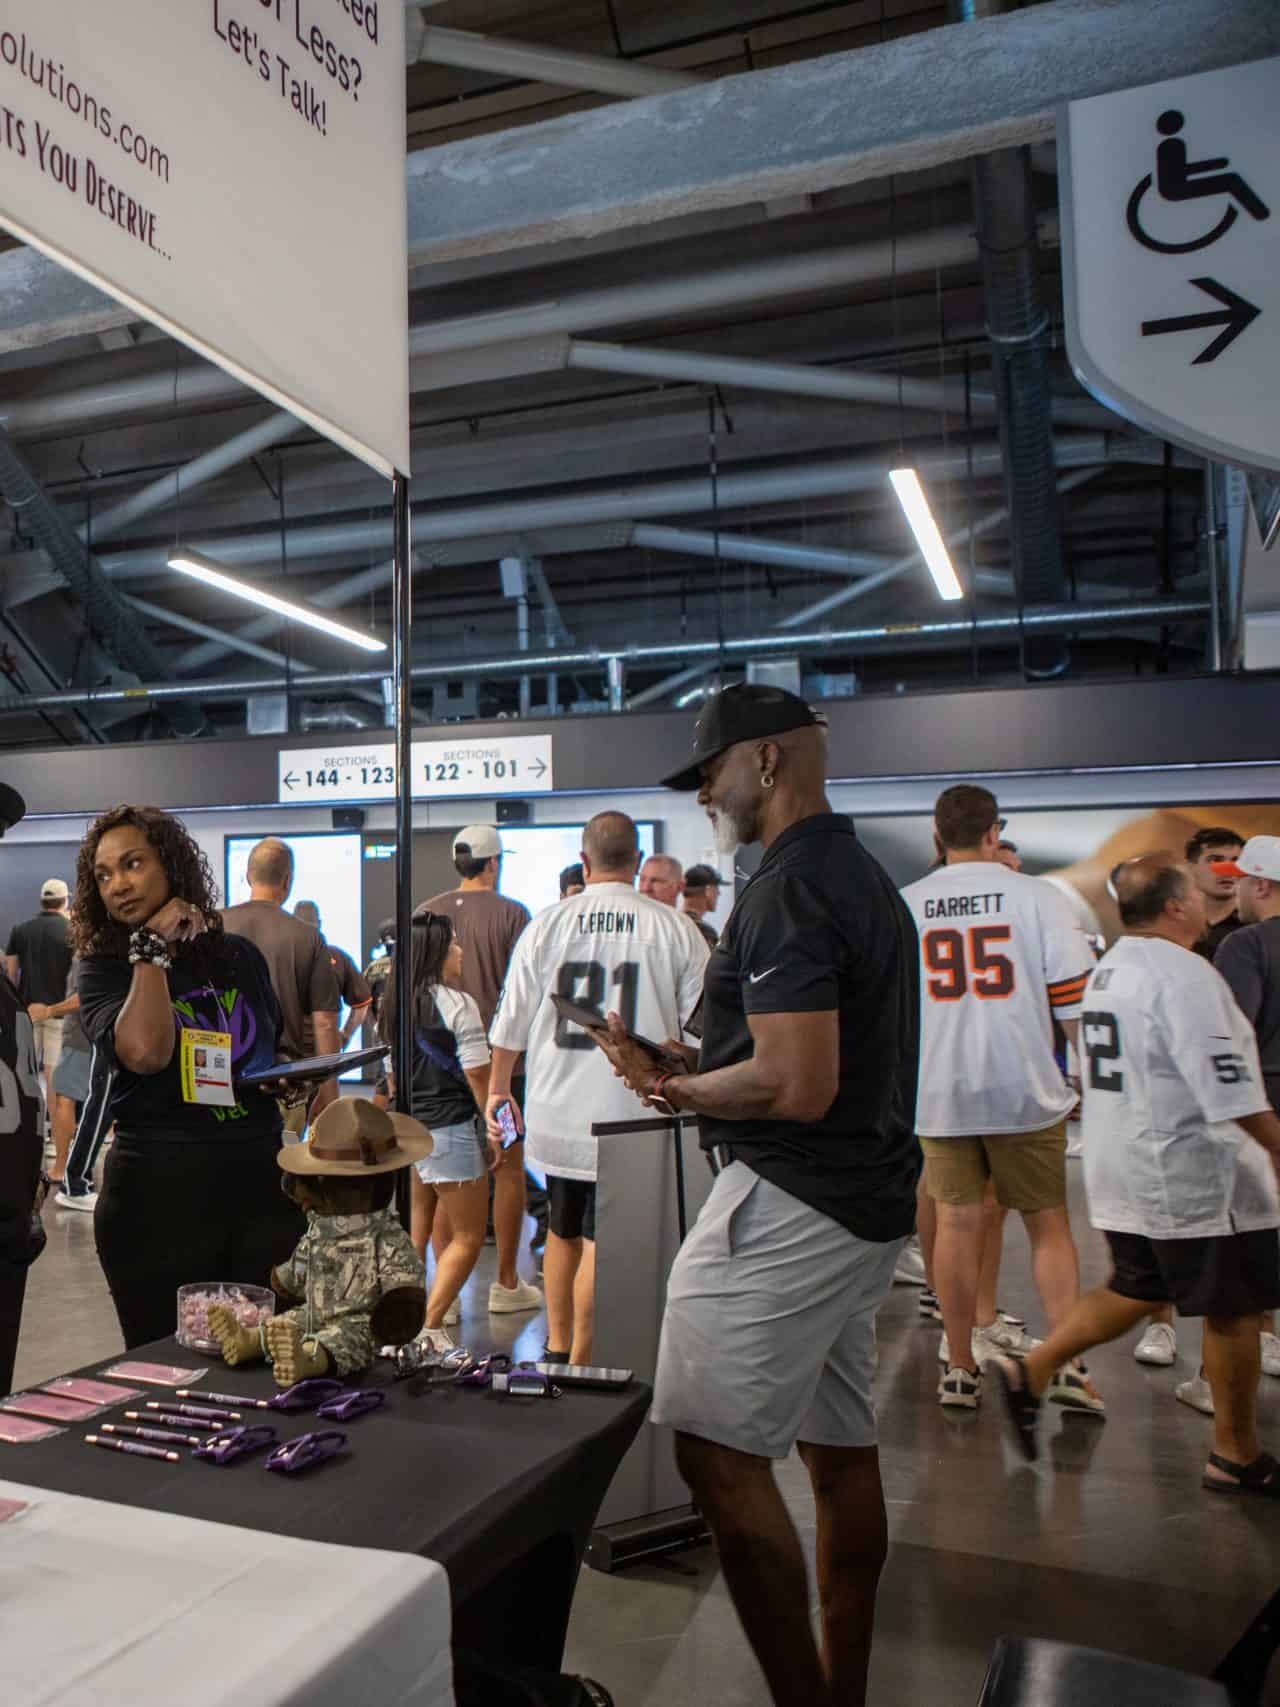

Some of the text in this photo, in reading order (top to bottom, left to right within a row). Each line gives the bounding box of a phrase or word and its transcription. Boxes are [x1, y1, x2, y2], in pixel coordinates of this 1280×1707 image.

[296, 0, 363, 101] Less?
[213, 0, 326, 136] Let's Talk!
[324, 755, 377, 768] SECTIONS
[443, 749, 501, 762] SECTIONS
[306, 769, 339, 787] 144
[361, 767, 395, 785] 123
[424, 762, 460, 782] 122
[483, 759, 518, 779] 101
[924, 893, 1005, 919] GARRETT
[922, 924, 1015, 1002] 95
